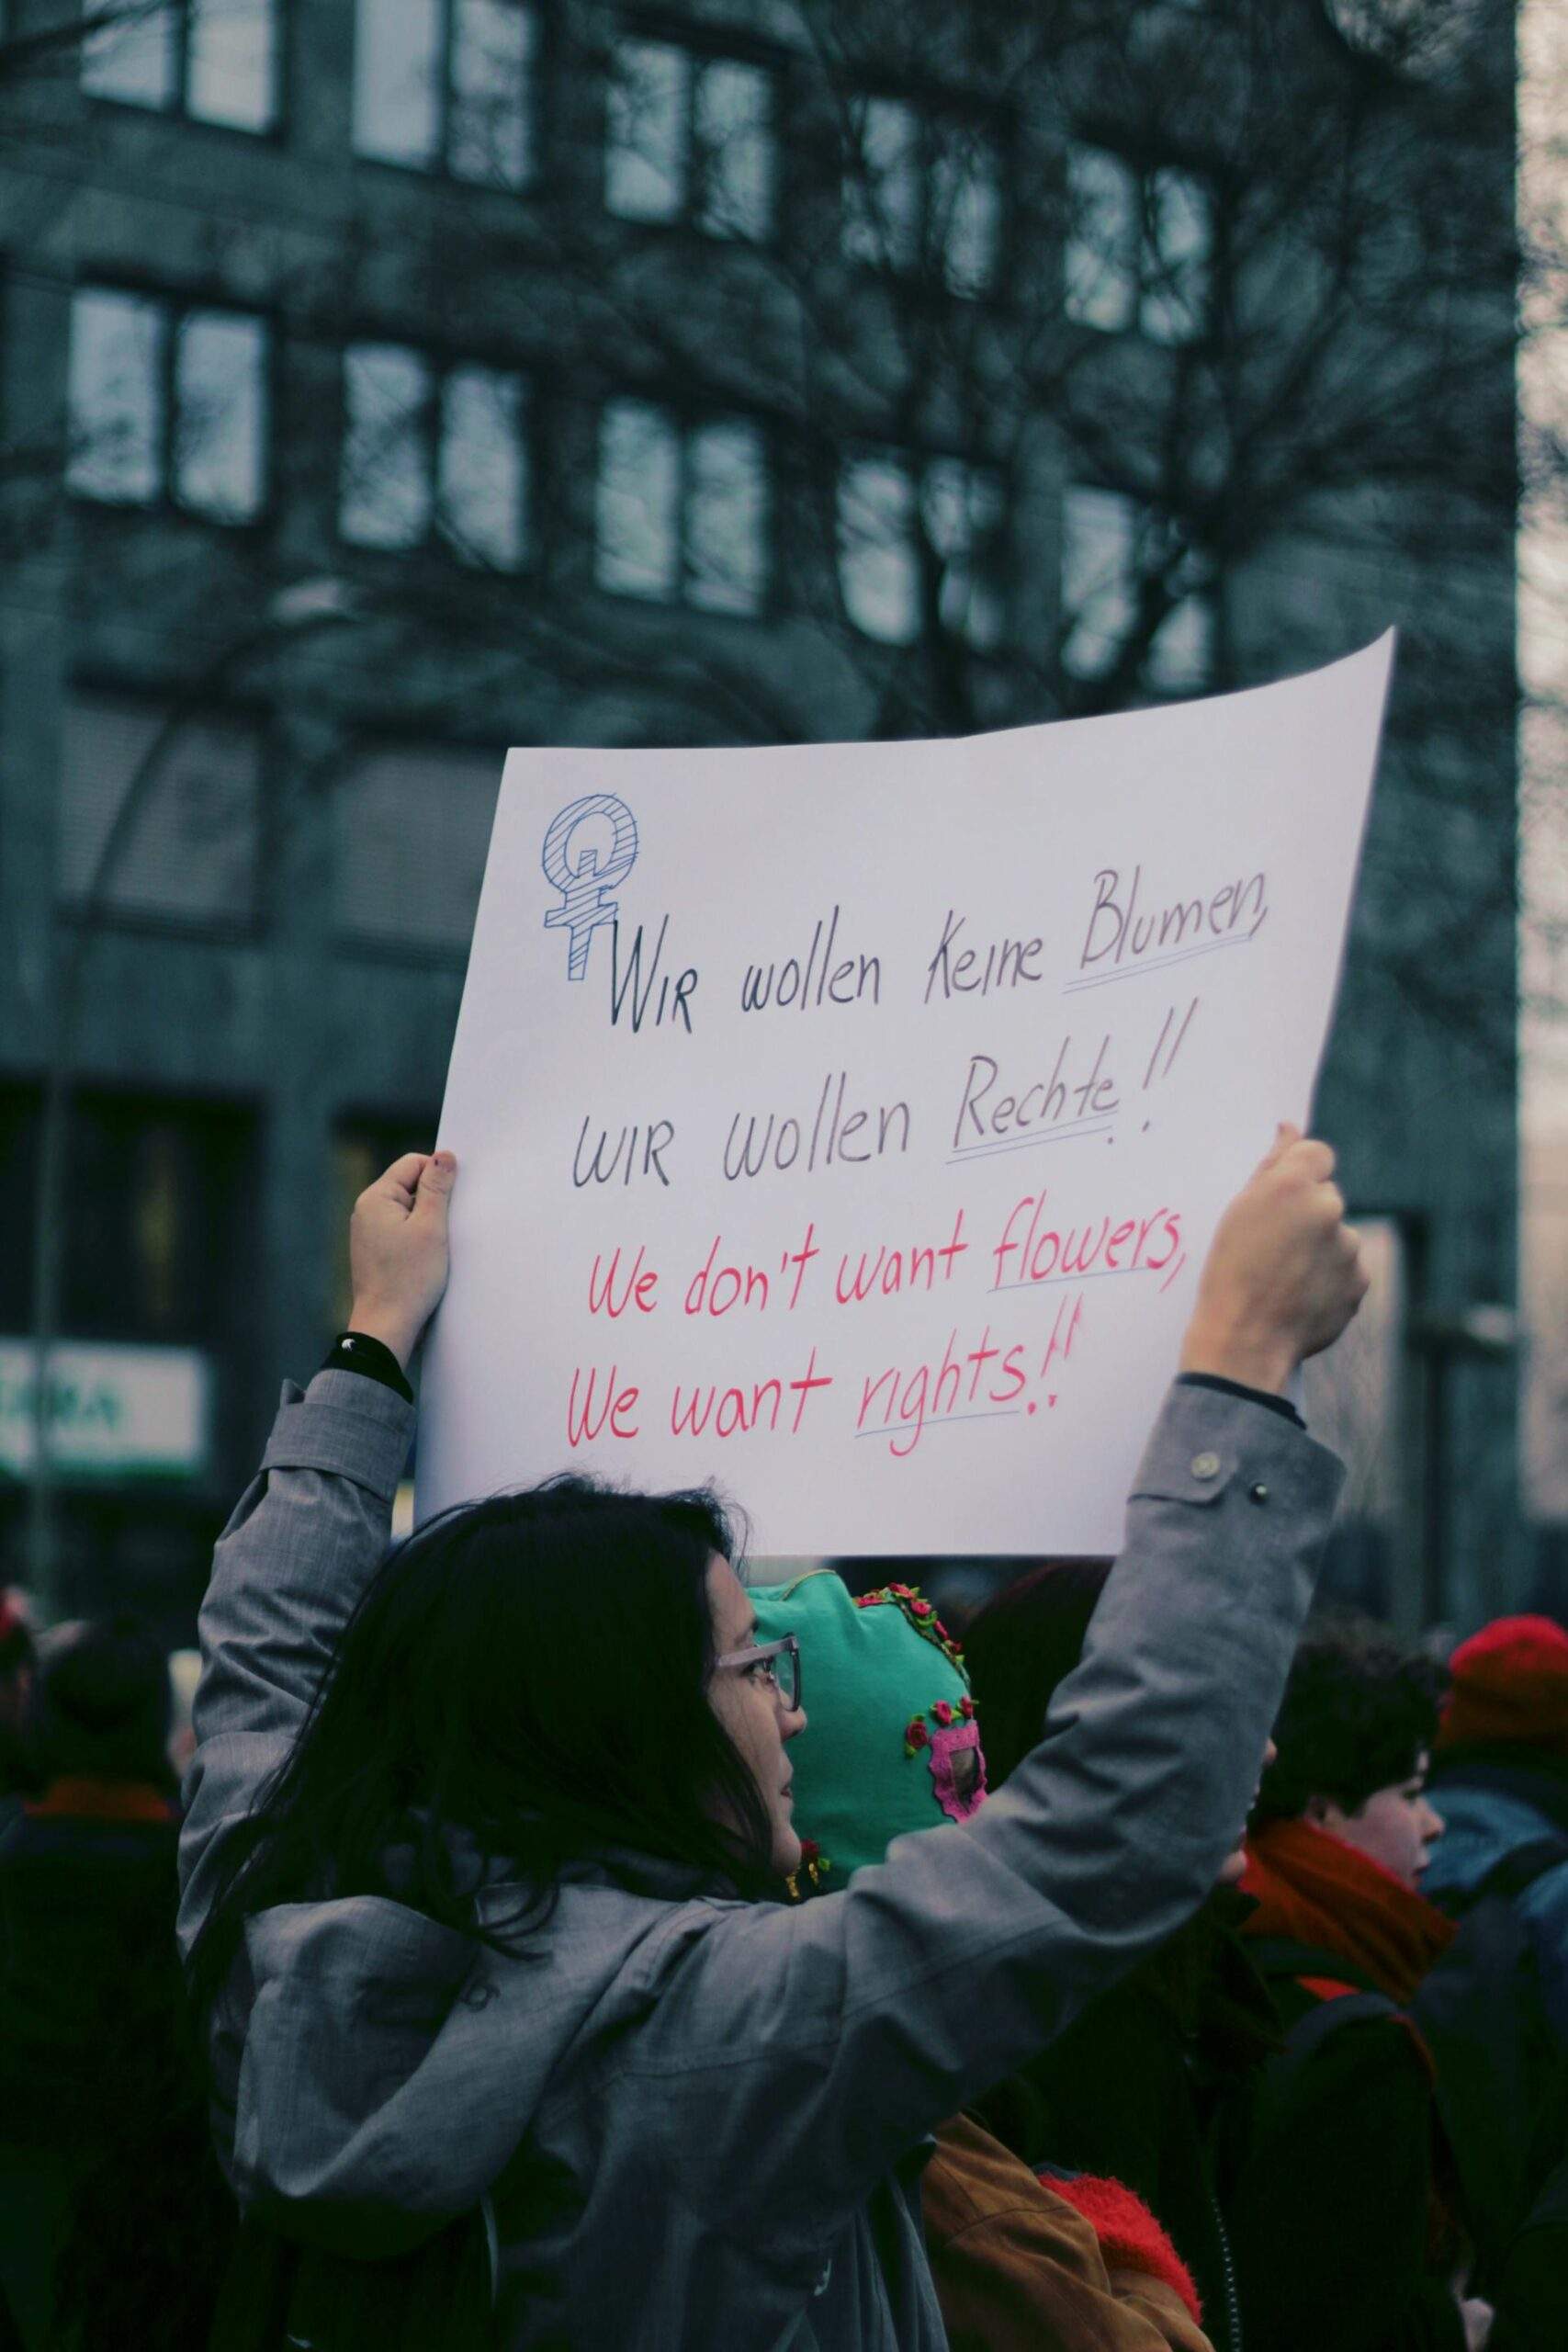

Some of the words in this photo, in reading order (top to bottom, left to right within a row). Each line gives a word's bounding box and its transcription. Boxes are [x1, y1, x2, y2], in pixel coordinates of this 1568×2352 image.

[741, 905, 880, 1012] wollen
[1080, 865, 1269, 970] Blumen,
[724, 1071, 910, 1182] wollen
[589, 1245, 659, 1318] We
[684, 1222, 820, 1317] don't
[836, 1208, 968, 1305] want
[993, 1189, 1187, 1294] flowers,
[568, 1363, 639, 1448] We
[671, 1346, 833, 1438] want
